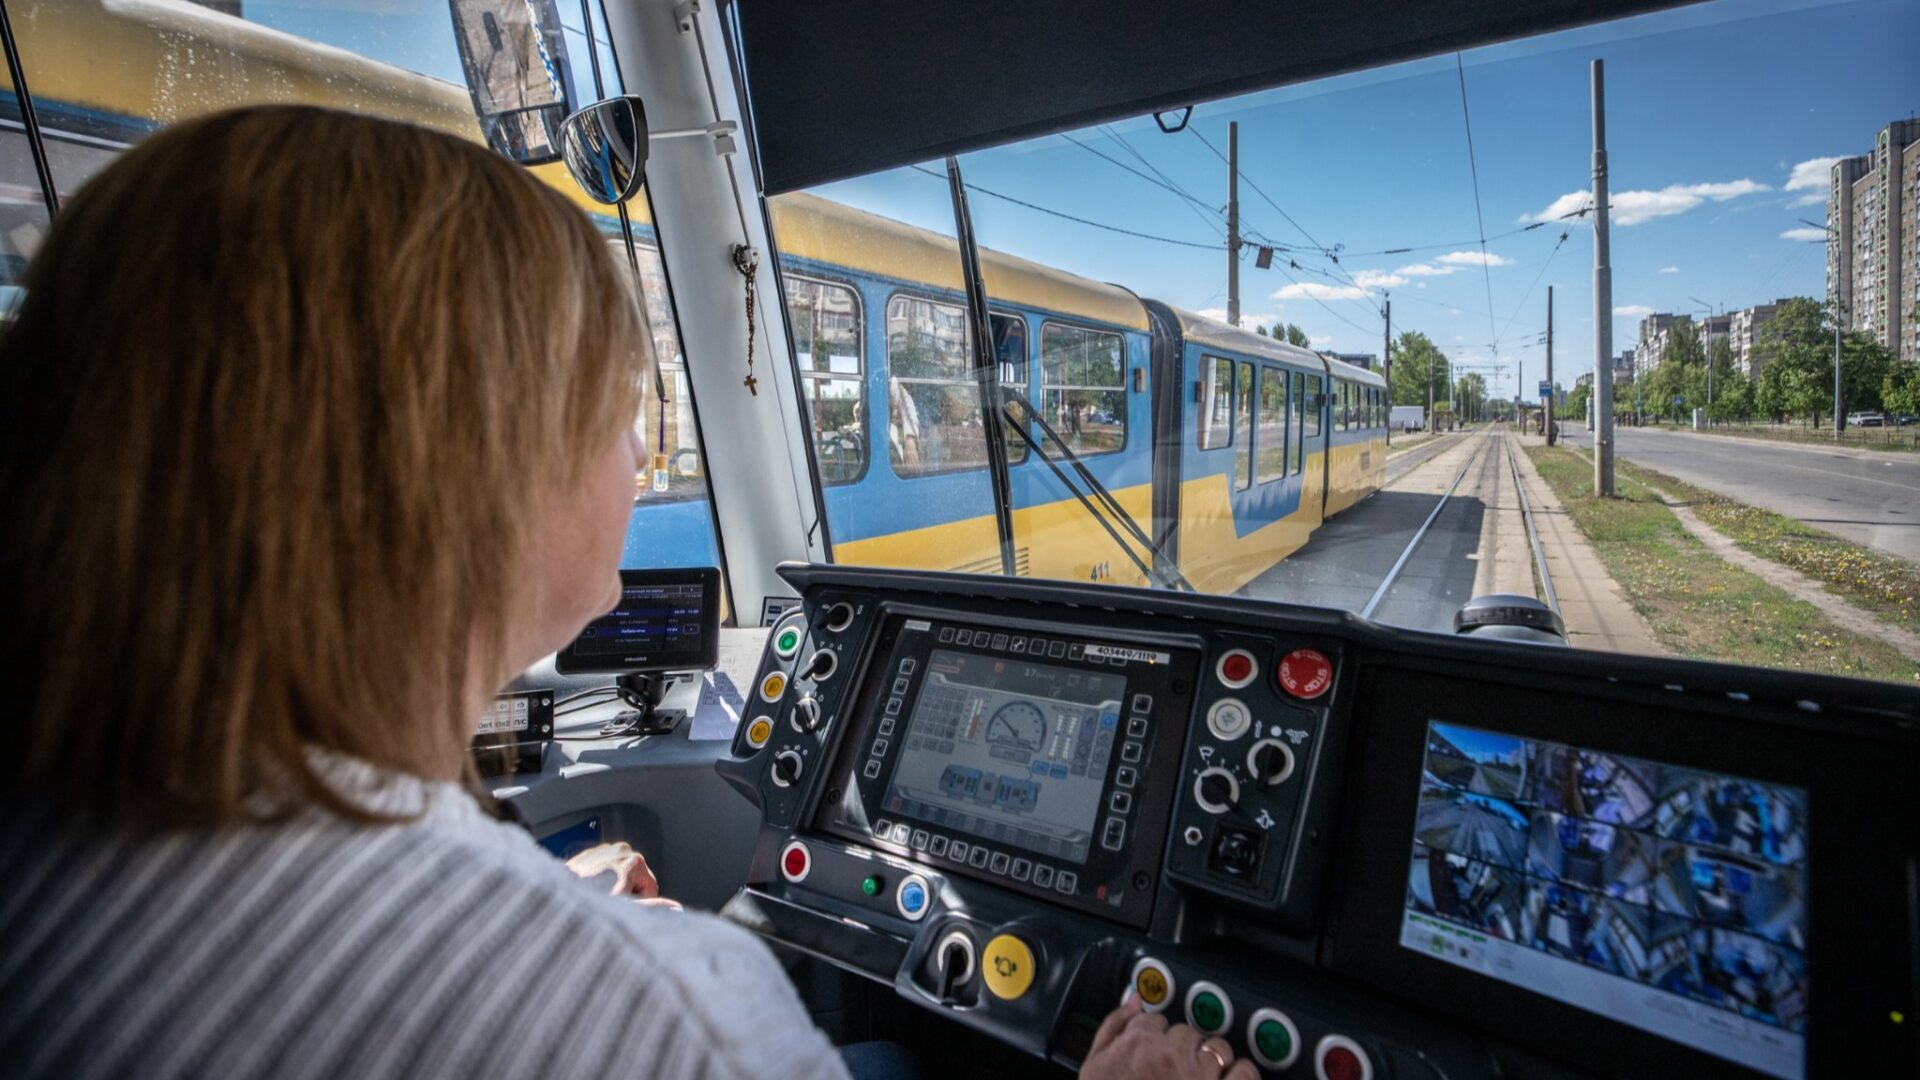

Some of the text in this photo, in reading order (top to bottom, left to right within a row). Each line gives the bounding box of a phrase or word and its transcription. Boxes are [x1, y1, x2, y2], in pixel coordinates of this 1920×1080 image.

[1091, 560, 1109, 581] 411
[1282, 662, 1297, 689] STOP
[1304, 668, 1328, 692] STOP
